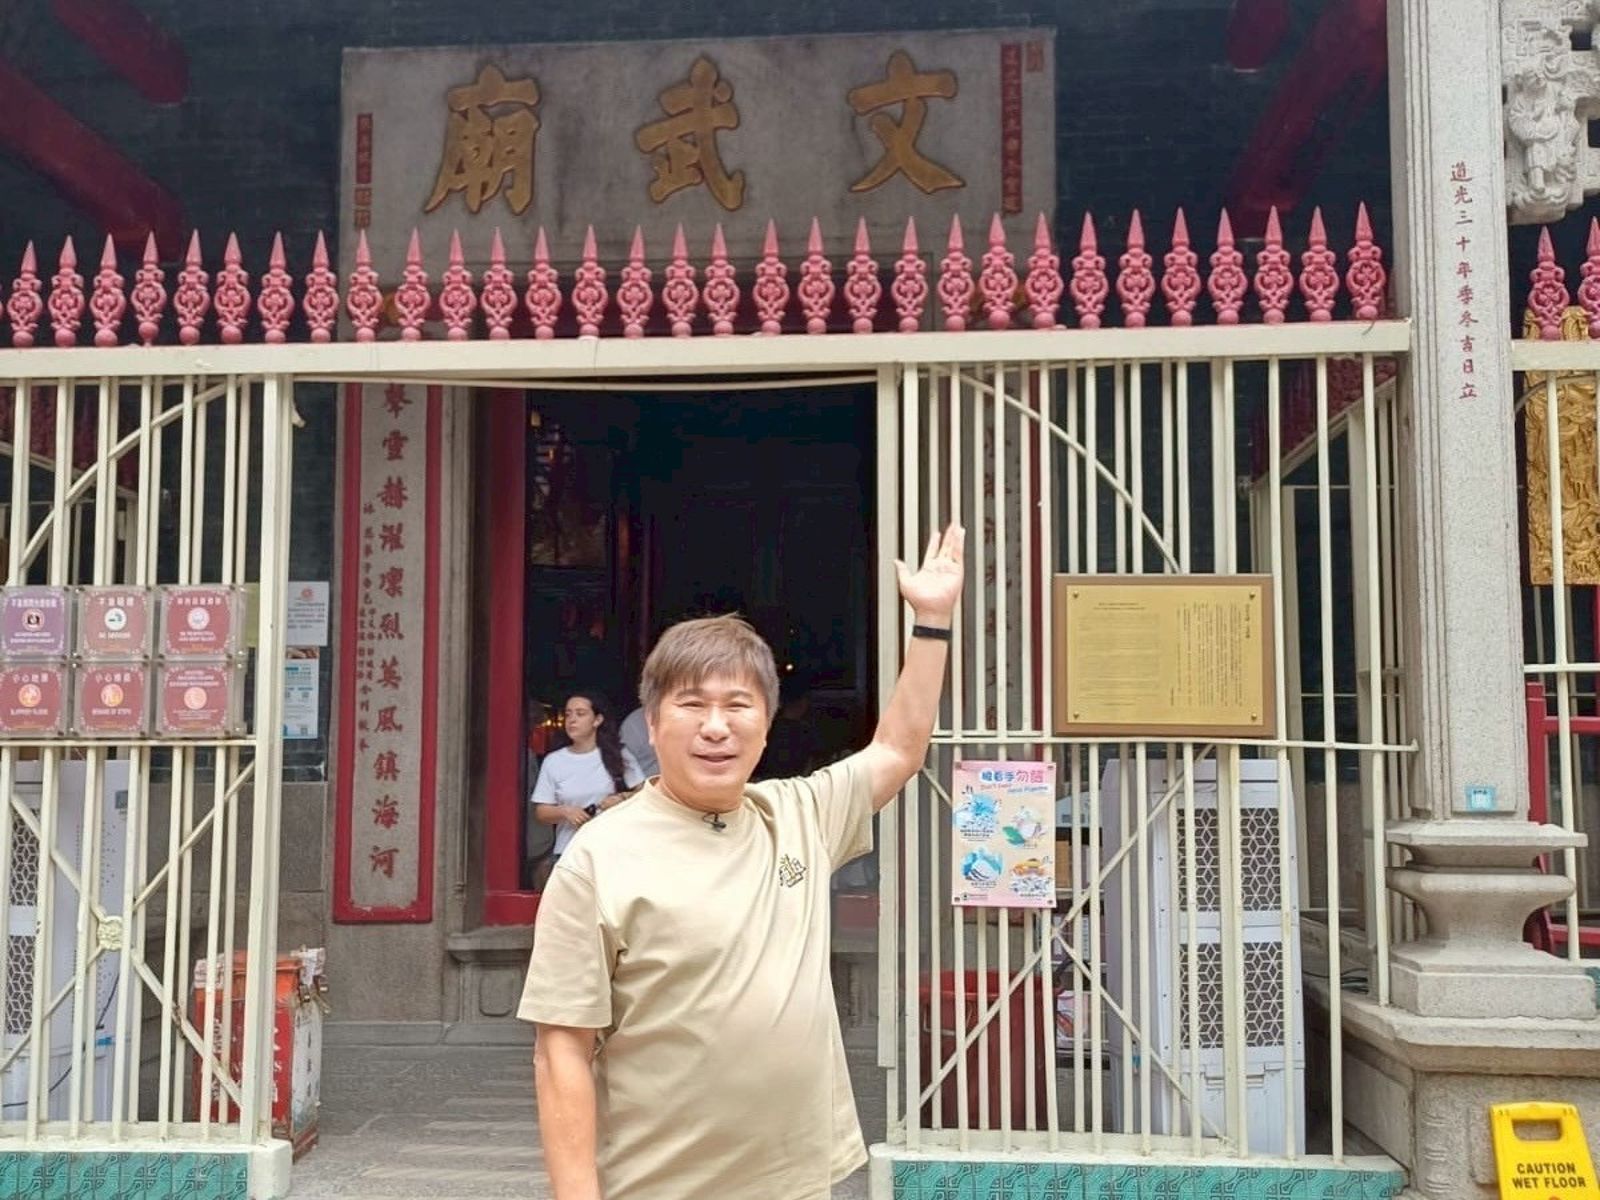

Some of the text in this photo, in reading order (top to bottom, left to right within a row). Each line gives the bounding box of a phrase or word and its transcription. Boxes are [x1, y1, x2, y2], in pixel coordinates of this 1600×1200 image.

[425, 49, 966, 216] 文武廟
[1450, 160, 1478, 399] 道光三十年季冬吉日立
[1512, 1177, 1586, 1189] WET FLOOR
[1517, 1162, 1576, 1175] CAUTION
